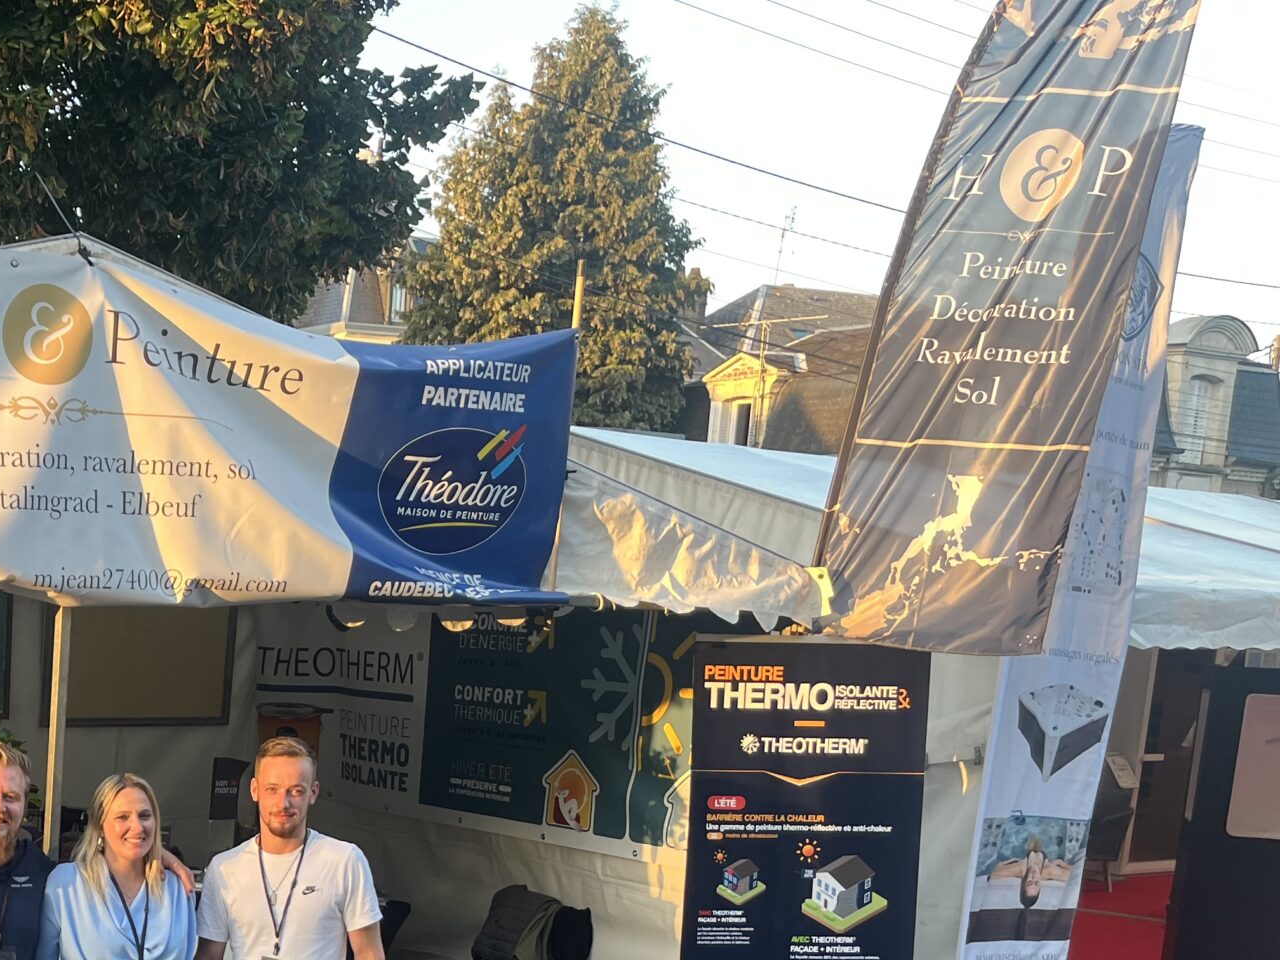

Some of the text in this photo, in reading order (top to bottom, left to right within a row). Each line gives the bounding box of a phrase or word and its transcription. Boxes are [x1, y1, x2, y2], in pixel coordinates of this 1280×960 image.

[942, 144, 1134, 203] H & P
[958, 251, 1068, 281] Peinture
[929, 294, 1076, 323] Décoration
[22, 301, 74, 365] &
[105, 308, 305, 396] Peinture
[916, 331, 1071, 367] Ravalement
[426, 359, 531, 384] APPLICATEUR
[421, 385, 526, 414] PARTENAIRE
[953, 376, 999, 406] Sol
[83, 450, 218, 483] ravalement,
[227, 459, 258, 480] sol
[396, 456, 521, 510] Théodore
[121, 490, 202, 518] Elbeuf
[397, 506, 501, 523] MAISON DE PEINTURE
[33, 567, 288, 597] m.jean27400@gmail.com
[704, 665, 784, 681] PEINTURE
[454, 684, 524, 706] CONFORT
[704, 682, 835, 711] THERMO
[835, 684, 898, 698] ISOLANTE
[834, 697, 897, 710] RÉFLECTIVE
[340, 709, 411, 739] PEINTURE
[454, 703, 522, 725] THERMIQUE
[339, 732, 410, 767] THERMO
[341, 762, 408, 793] ISOLANTE
[451, 760, 485, 778] HIVER
[706, 812, 743, 822] BARRIÈRE
[744, 814, 774, 822] CONTRE
[790, 945, 819, 954] FAÇADE
[825, 944, 861, 953] INTÉRIEUR
